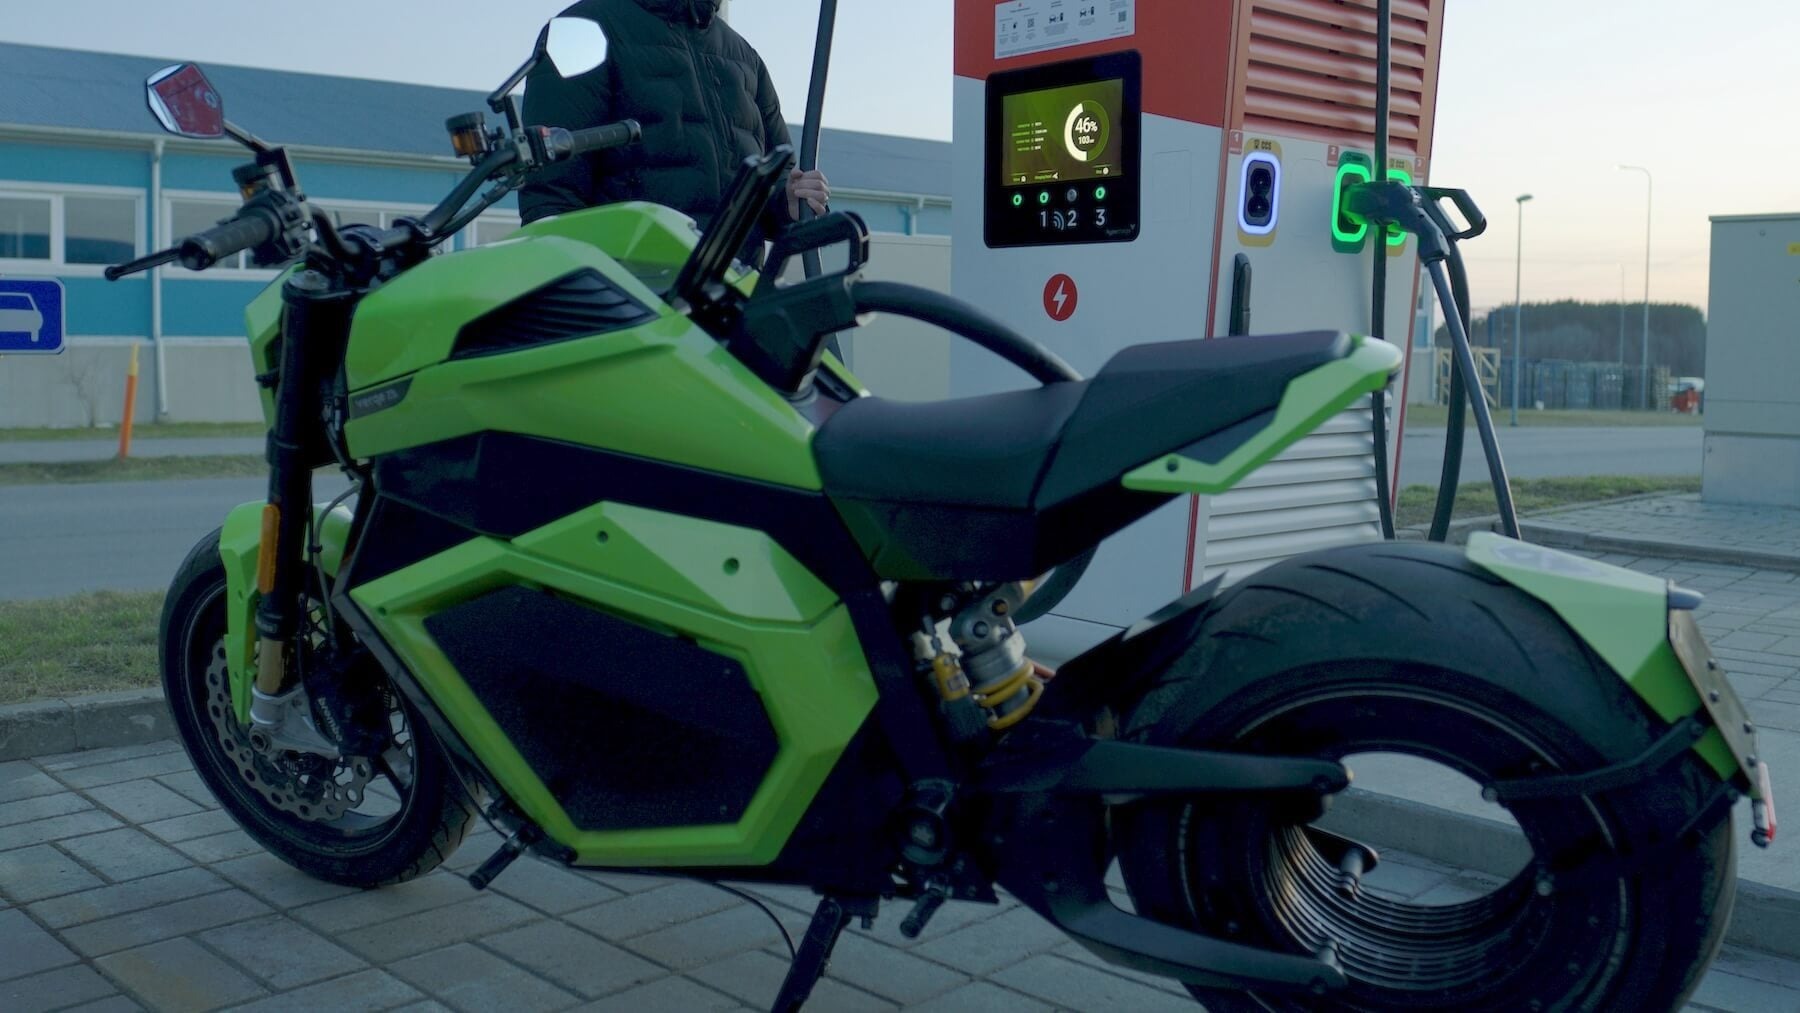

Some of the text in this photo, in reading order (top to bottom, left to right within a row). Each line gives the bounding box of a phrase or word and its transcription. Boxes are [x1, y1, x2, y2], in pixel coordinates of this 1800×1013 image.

[1075, 117, 1098, 133] 46%
[1040, 209, 1105, 227] 1 2 3
[317, 697, 343, 741] brembo
